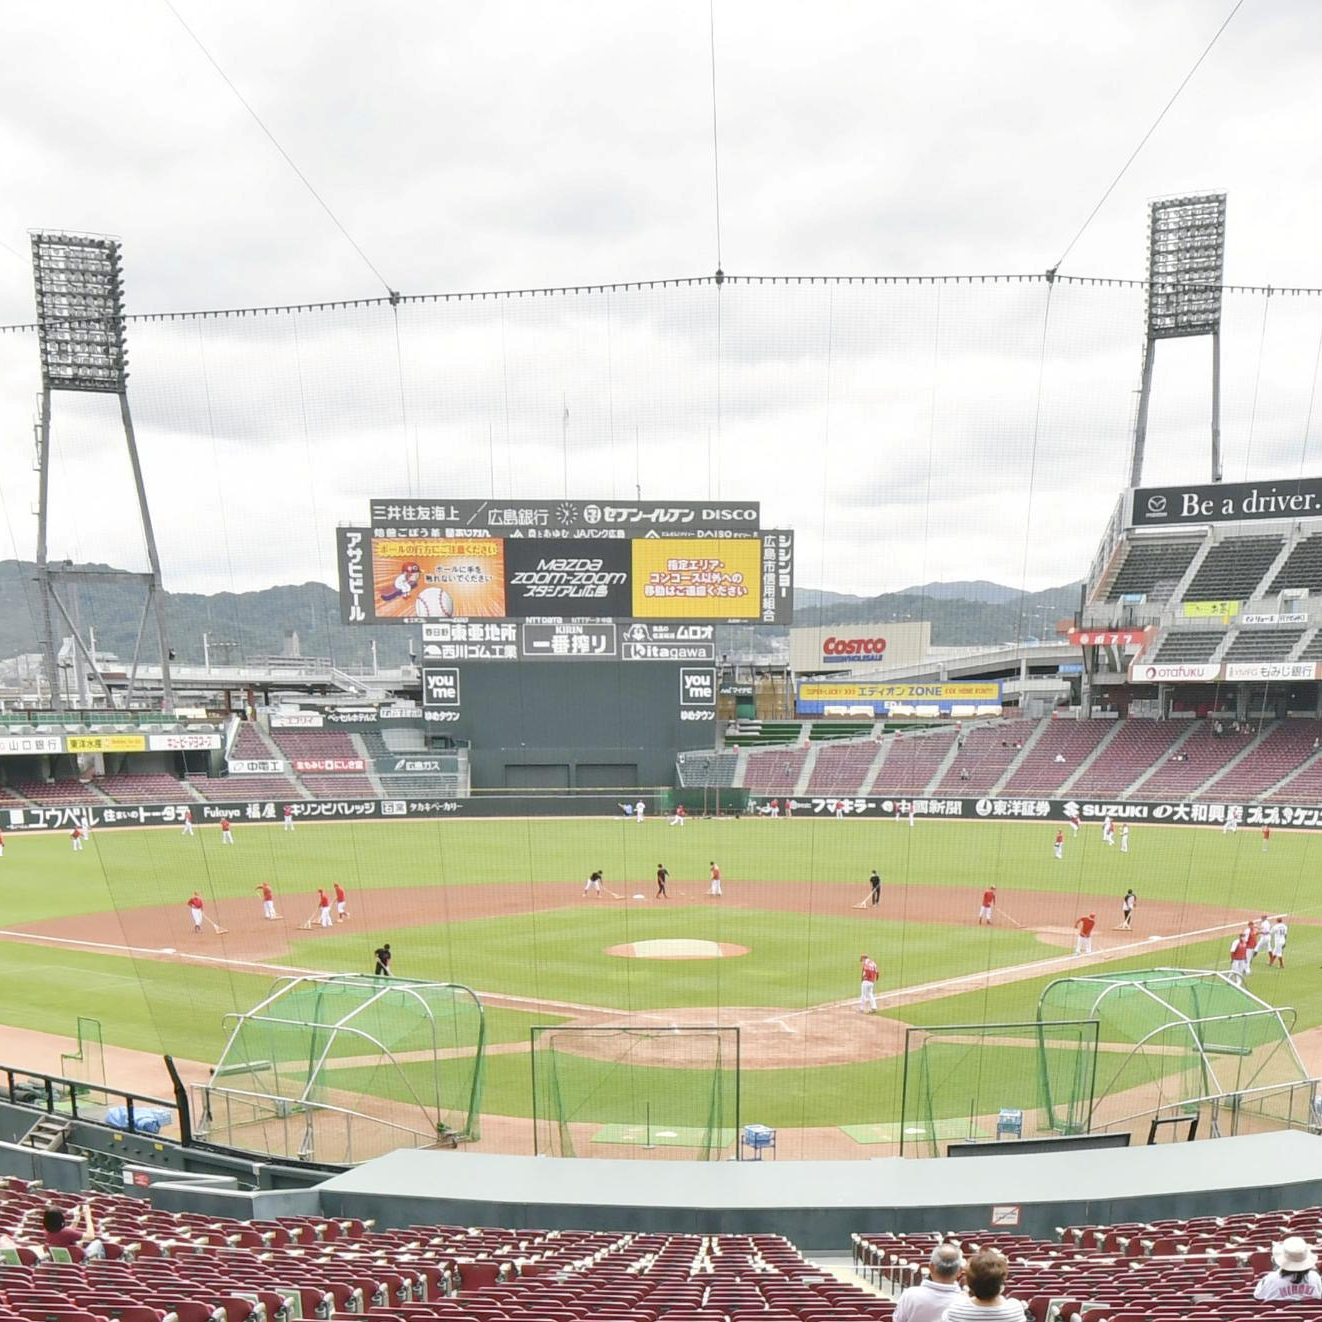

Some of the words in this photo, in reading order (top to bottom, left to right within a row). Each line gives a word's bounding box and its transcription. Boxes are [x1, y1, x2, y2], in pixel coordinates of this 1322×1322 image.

[1181, 491, 1213, 517] Be
[1221, 498, 1234, 515] a
[1242, 488, 1322, 514] driver.
[373, 505, 460, 521] 三井住友海上
[488, 508, 550, 526] 広島銀行
[702, 509, 758, 521] DISCO
[697, 529, 733, 538] DAISO
[346, 531, 365, 621] アサヒビール
[649, 572, 744, 583] コンコース以外への
[763, 534, 776, 622] 広島市信用組合
[523, 585, 609, 597] スタジアム広島
[451, 623, 518, 641] 東亜地所
[555, 625, 583, 634] KIRIN
[532, 634, 607, 653] 一番搾り
[441, 644, 518, 659] 西川ゴム工業
[1260, 665, 1313, 678] もみじ銀行
[427, 675, 454, 688] you
[684, 675, 711, 688] you
[432, 686, 456, 698] me
[689, 686, 713, 698] me
[858, 687, 905, 697] エディオン
[908, 686, 942, 697] ZONE
[424, 711, 460, 721] ゆめタウン
[680, 710, 716, 720] ゆめタウン
[8, 739, 57, 751] 山口銀行
[246, 761, 279, 771] 中電工
[245, 804, 277, 819] 福屋
[992, 800, 1052, 817] 東洋証券
[1082, 805, 1149, 819] SUZUKI
